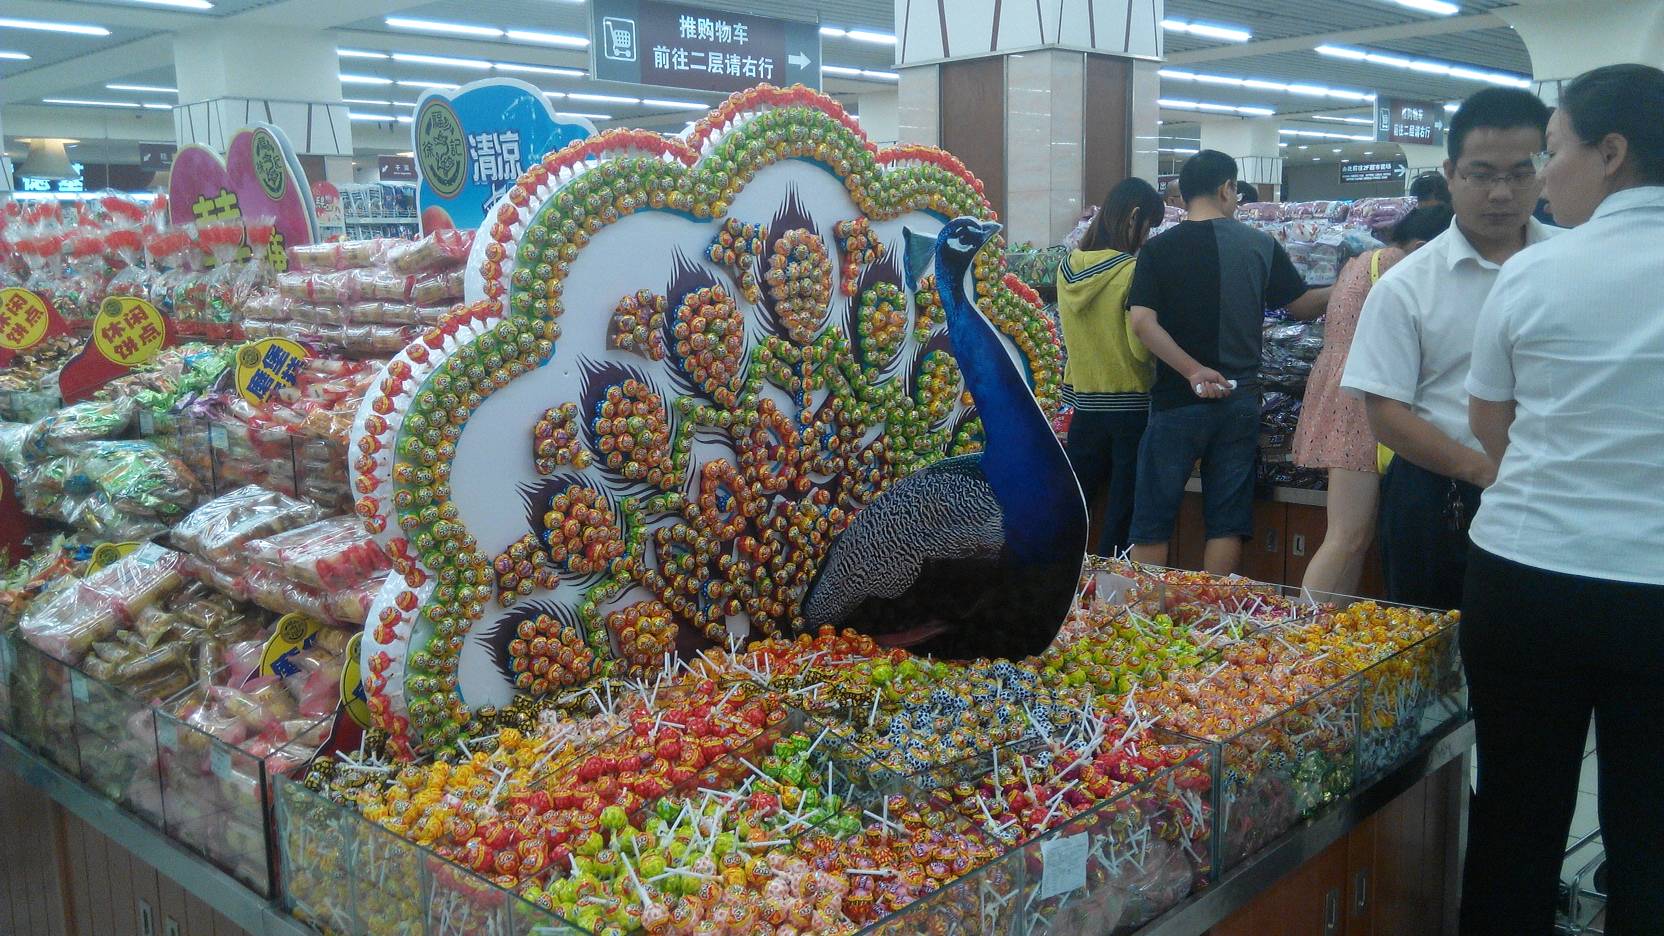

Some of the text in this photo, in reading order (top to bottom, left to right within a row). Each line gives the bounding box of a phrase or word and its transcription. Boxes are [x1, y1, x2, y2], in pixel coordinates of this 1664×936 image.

[679, 15, 749, 45] 推购物车
[653, 46, 774, 80] 前往二层请右行
[468, 130, 524, 186] 清凉
[102, 304, 149, 344] 休闲
